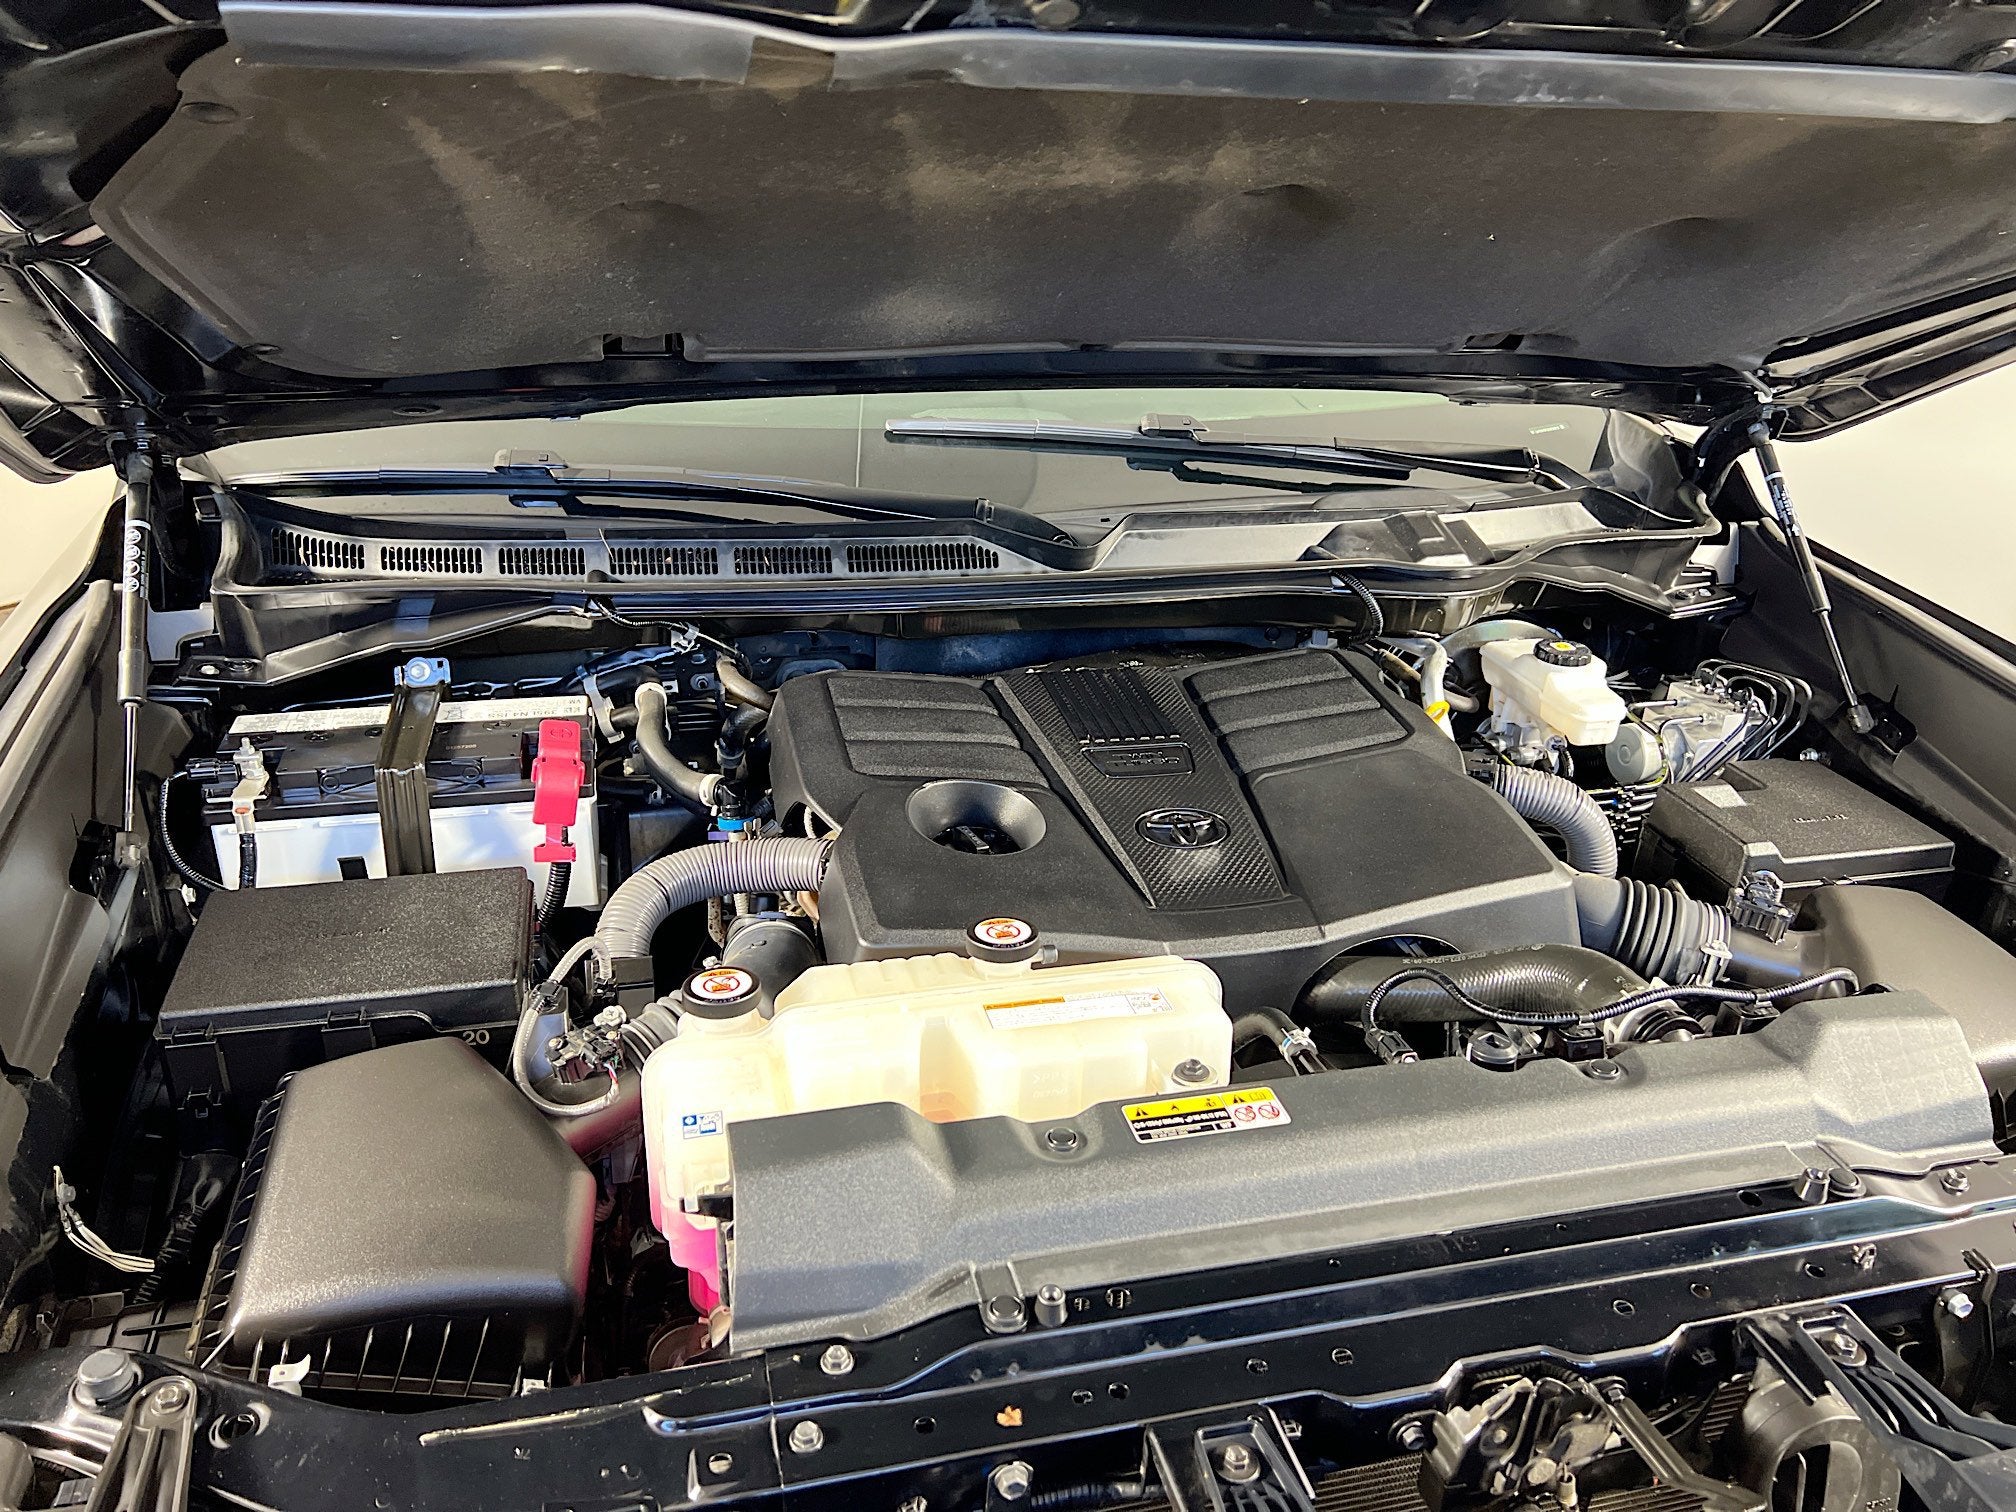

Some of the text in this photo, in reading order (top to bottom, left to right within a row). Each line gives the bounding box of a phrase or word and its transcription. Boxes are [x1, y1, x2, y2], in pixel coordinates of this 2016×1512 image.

[1111, 751, 1164, 760] TWIN
[1106, 756, 1180, 767] TURBO
[462, 1029, 490, 1046] 20
